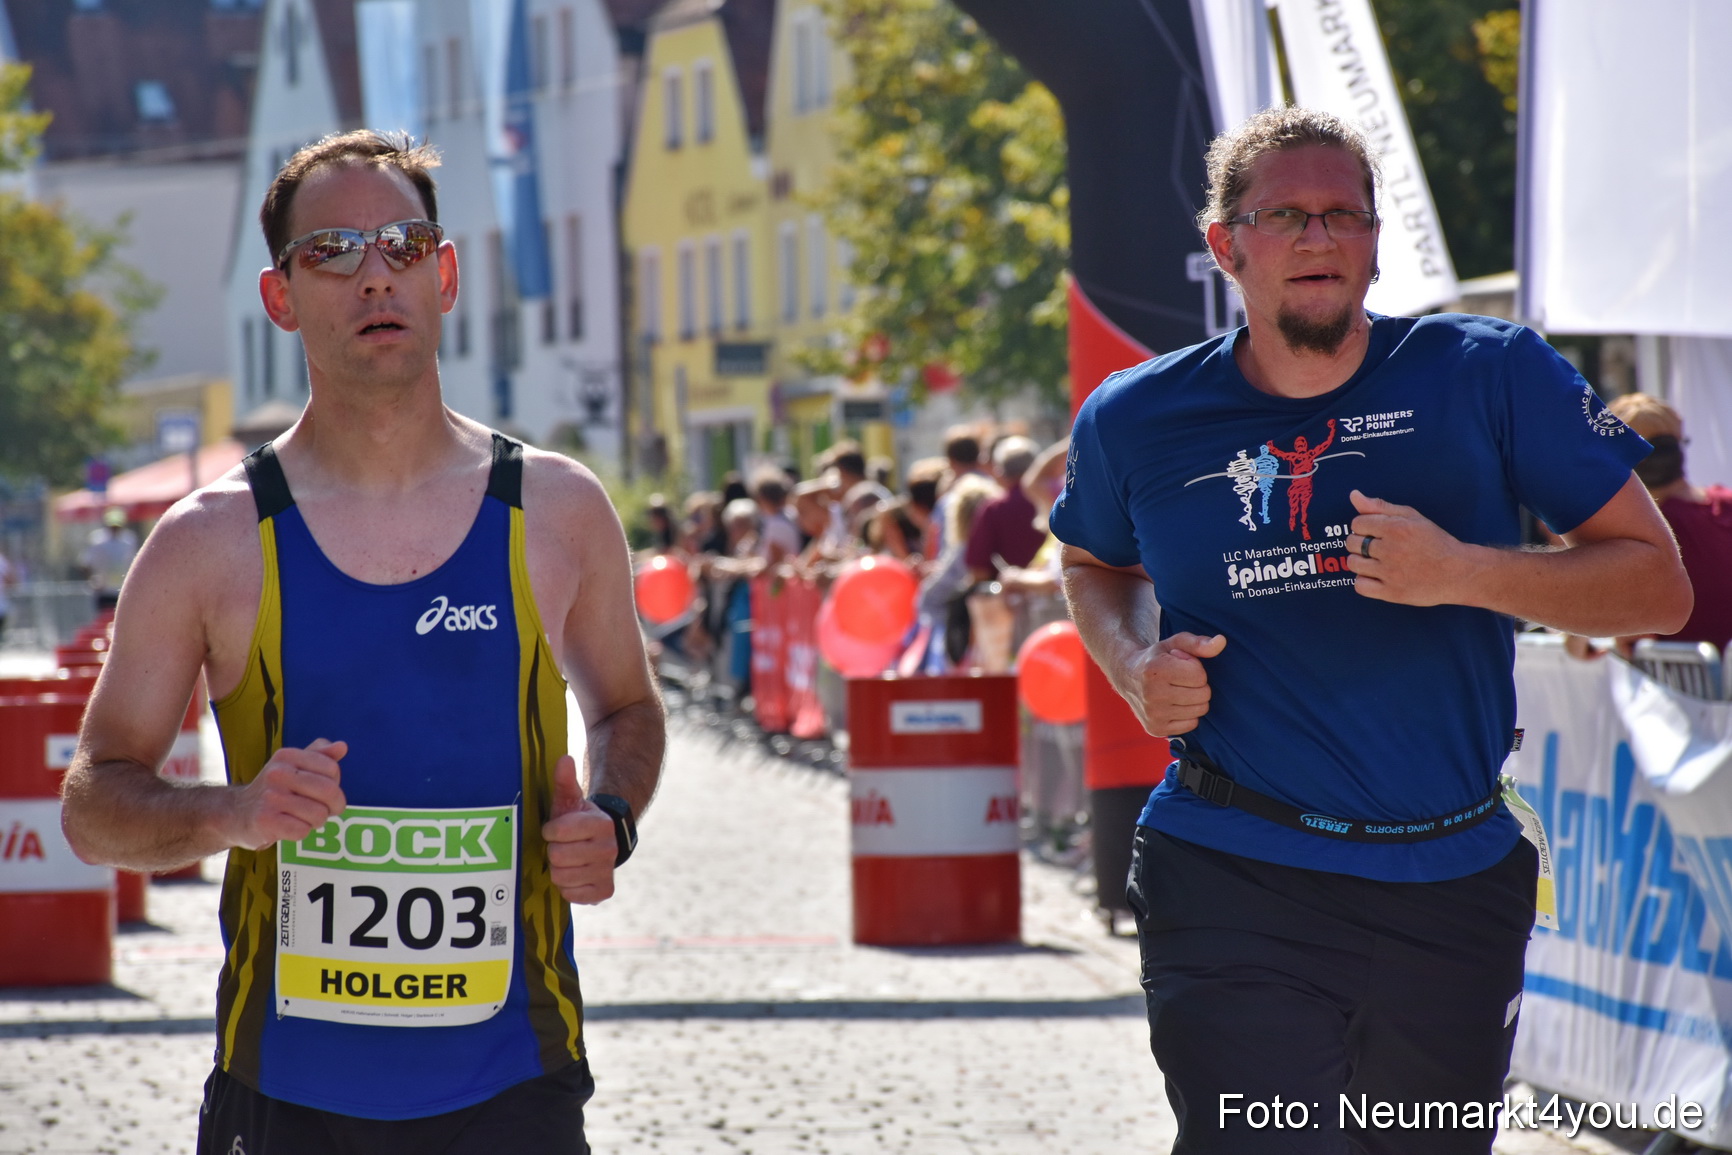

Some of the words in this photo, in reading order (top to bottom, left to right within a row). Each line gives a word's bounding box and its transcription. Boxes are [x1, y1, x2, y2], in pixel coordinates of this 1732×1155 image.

[1389, 163, 1442, 280] PARTL
[1366, 420, 1396, 430] POINT
[1341, 428, 1415, 443] Donau-Einkaufszentrum
[1324, 524, 1355, 537] 201
[1223, 550, 1242, 563] LLC
[1245, 545, 1297, 560] Marathon
[1232, 590, 1245, 599] im
[1248, 577, 1357, 598] Donau-Einkaufszentru
[444, 605, 498, 632] asics
[1305, 817, 1349, 834] FERSTL
[1454, 814, 1463, 823] 00
[1365, 825, 1405, 834] SPORTS
[1407, 822, 1435, 833] LIVING
[296, 815, 498, 866] BOCK
[495, 889, 505, 901] C
[307, 882, 486, 950] 1203
[321, 968, 468, 999] HOLGER
